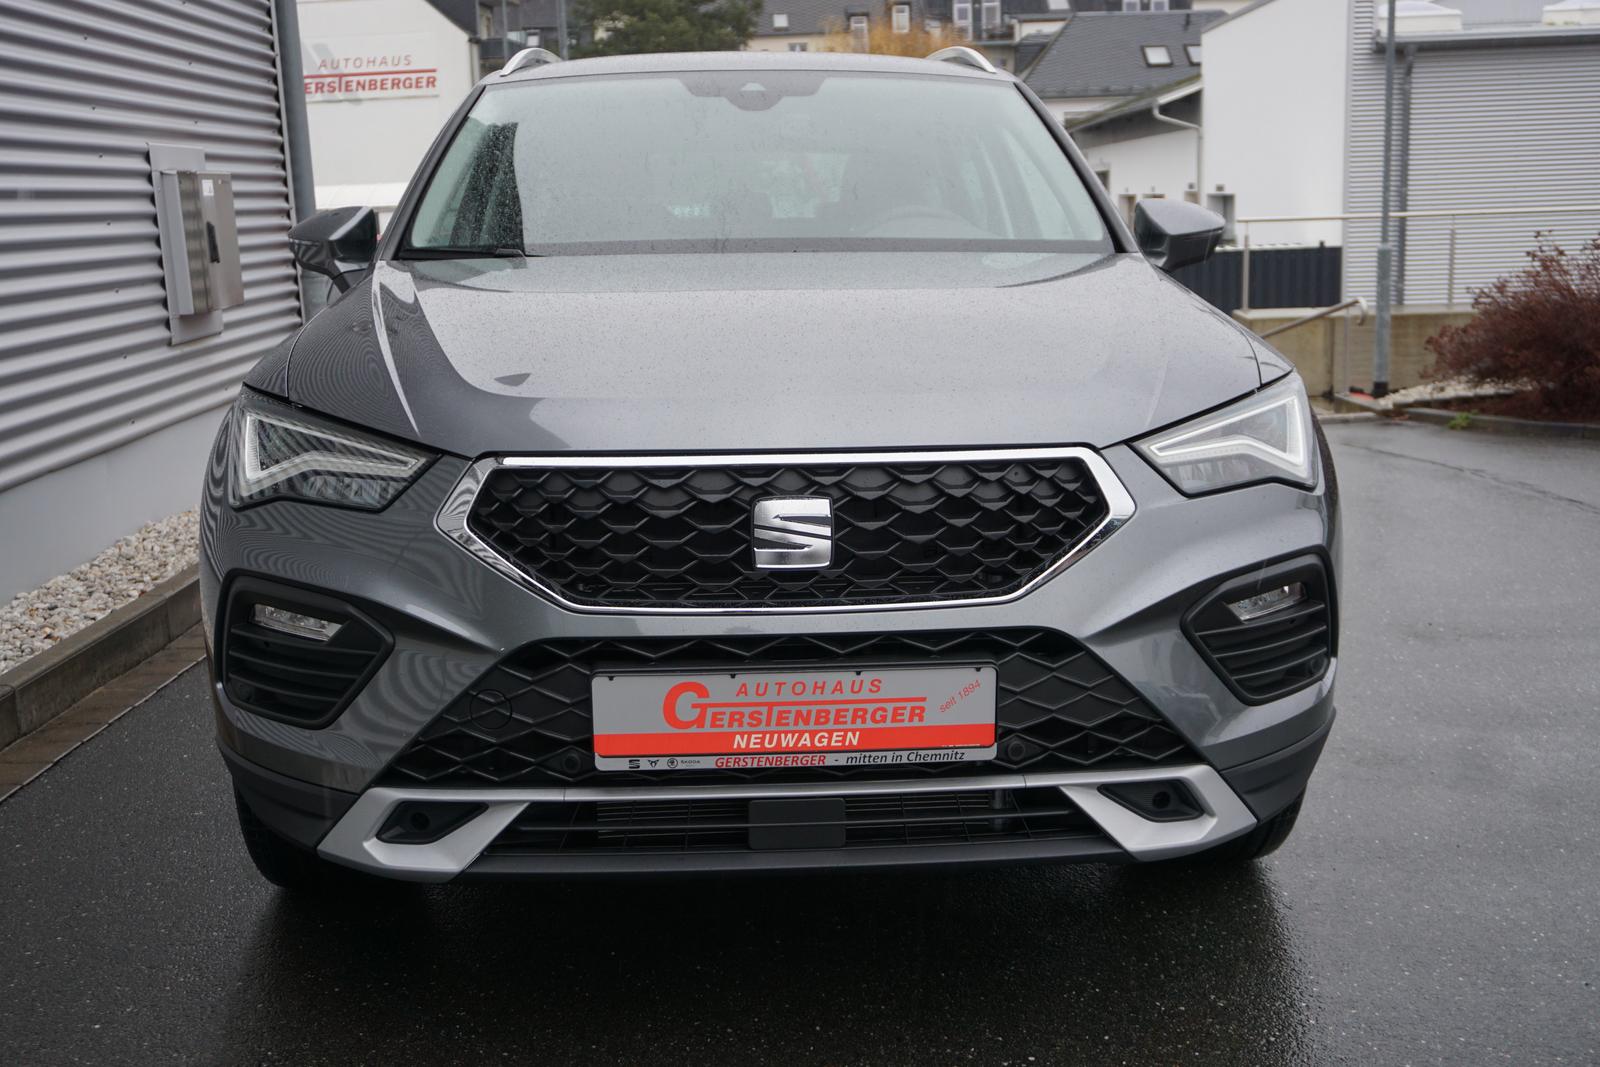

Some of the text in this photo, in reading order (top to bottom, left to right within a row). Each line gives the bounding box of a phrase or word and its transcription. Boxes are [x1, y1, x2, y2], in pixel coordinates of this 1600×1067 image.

[318, 54, 413, 71] AUTOHAUS
[304, 76, 437, 94] ERSTENBERGER
[736, 679, 883, 697] AUTOHAUS
[958, 679, 981, 700] 1894
[662, 681, 927, 730] GERSTENBERGER
[733, 731, 860, 749] NEUWAGEN
[715, 755, 826, 768] GERSTENBERGER
[846, 752, 888, 764] mitten
[891, 750, 903, 762] in
[906, 750, 965, 762] Chemnitz
